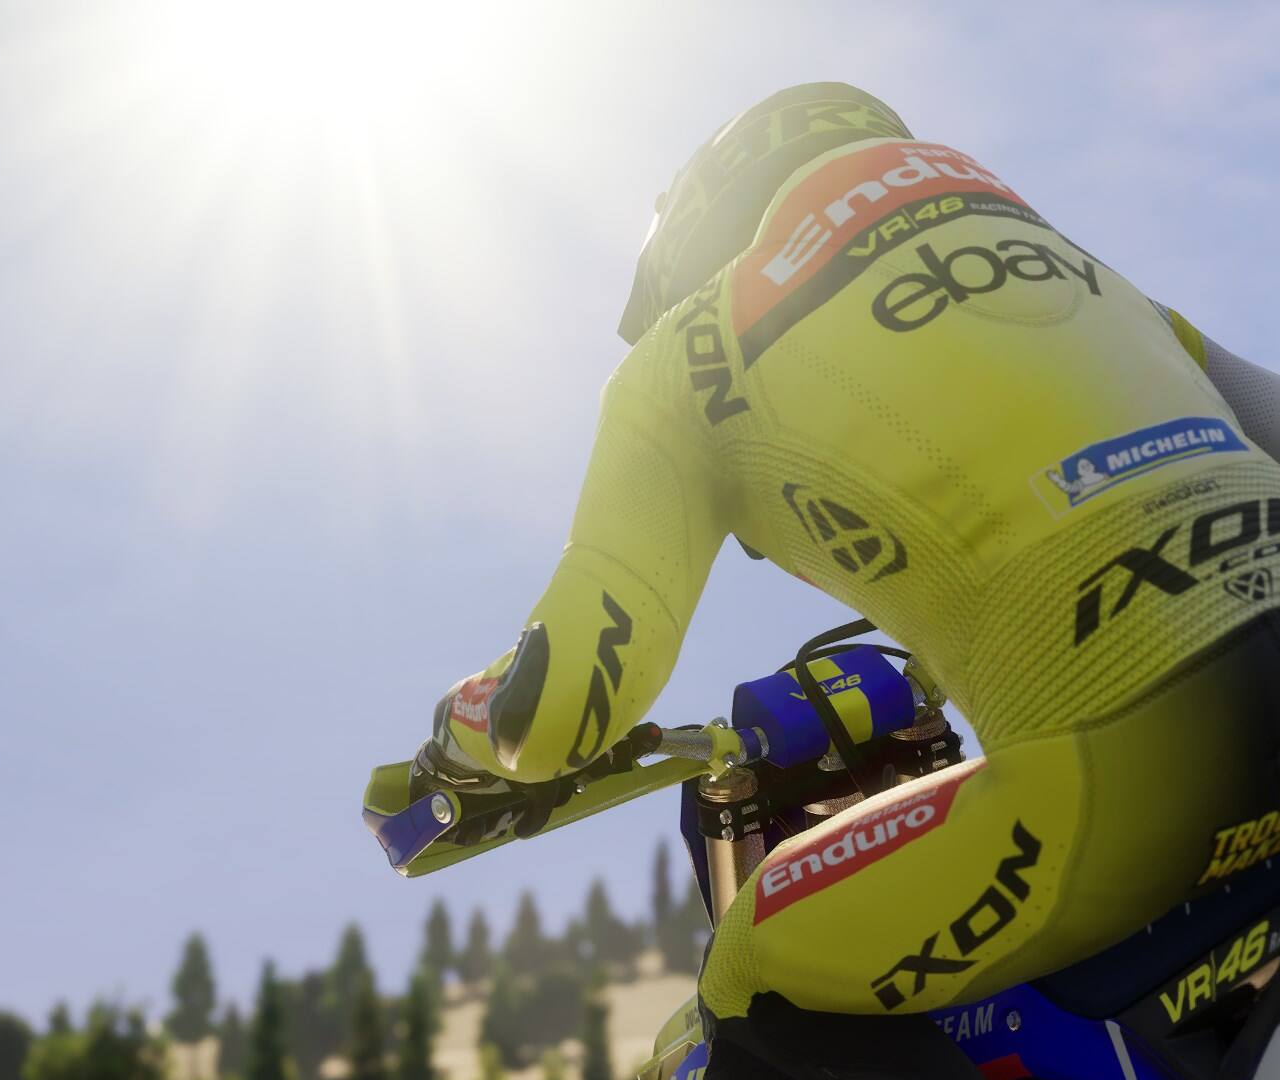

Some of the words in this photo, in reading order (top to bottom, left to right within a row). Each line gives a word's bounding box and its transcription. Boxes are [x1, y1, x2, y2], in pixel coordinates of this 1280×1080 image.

[761, 156, 1011, 286] Endur
[872, 239, 1102, 333] ebay
[1106, 427, 1226, 471] MICHELIN
[761, 804, 936, 898] Enduro
[936, 1002, 994, 1042] EAM
